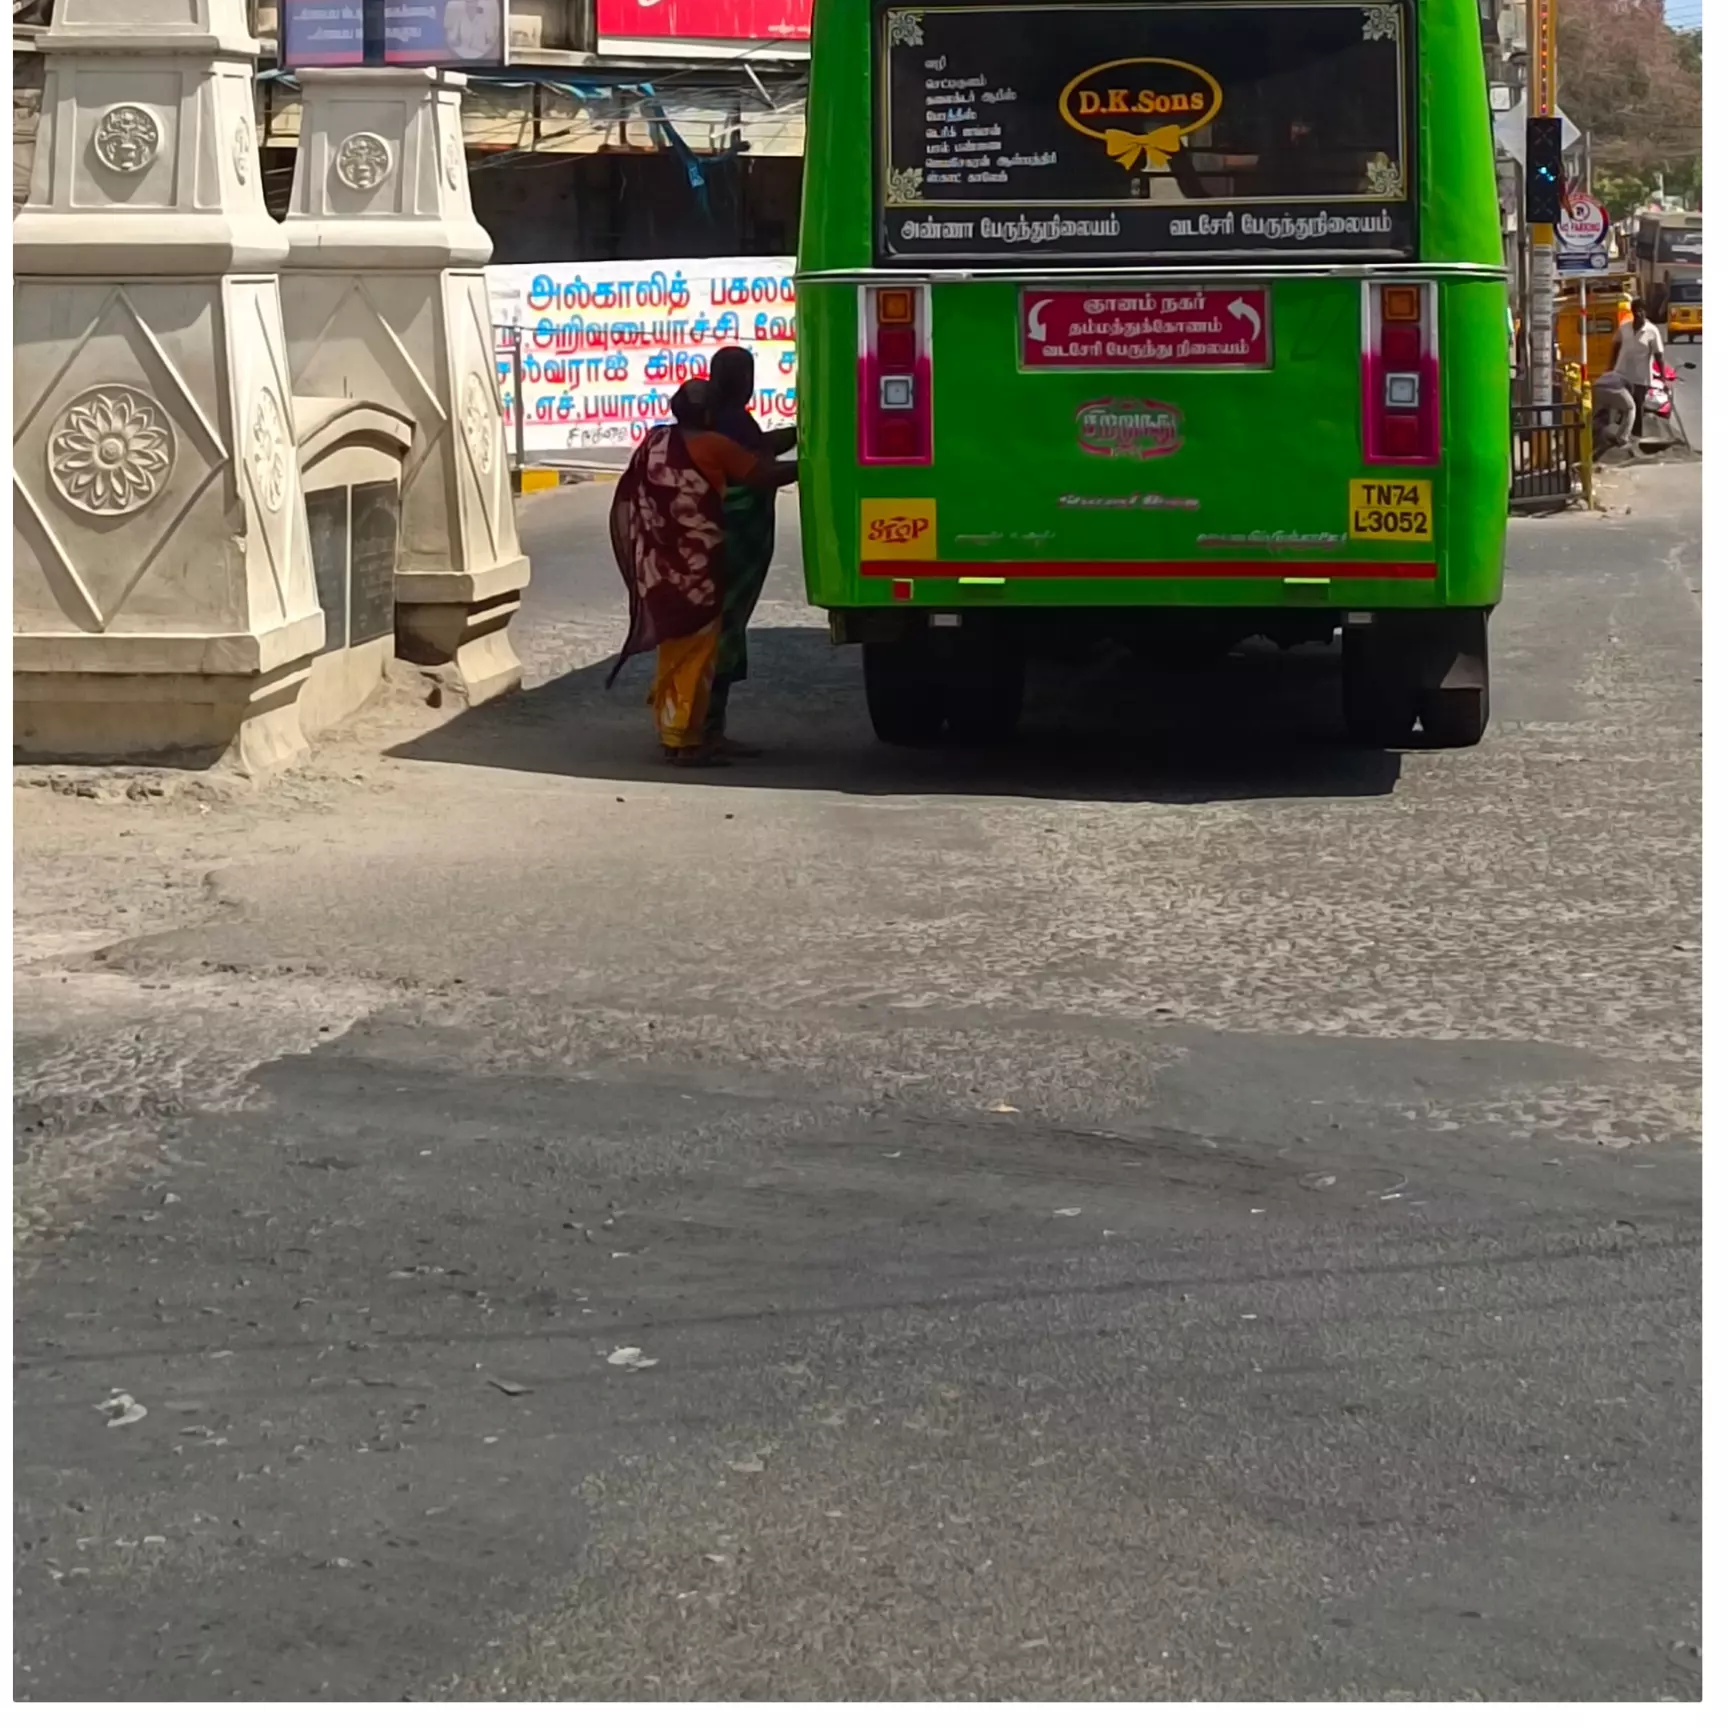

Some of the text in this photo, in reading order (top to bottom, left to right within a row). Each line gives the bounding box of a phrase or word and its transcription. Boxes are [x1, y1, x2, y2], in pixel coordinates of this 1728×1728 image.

[1079, 88, 1204, 116] D.K.Sons
[900, 215, 974, 240] அண்ணா
[1169, 210, 1235, 236] வடசேரி
[1083, 291, 1207, 314] ஞானம் நகர்
[1042, 338, 1250, 359] வடசேரி பேருந்து நிலையம்
[1362, 484, 1420, 508] TN74
[866, 516, 930, 544] STOP
[1354, 511, 1429, 535] L3052
